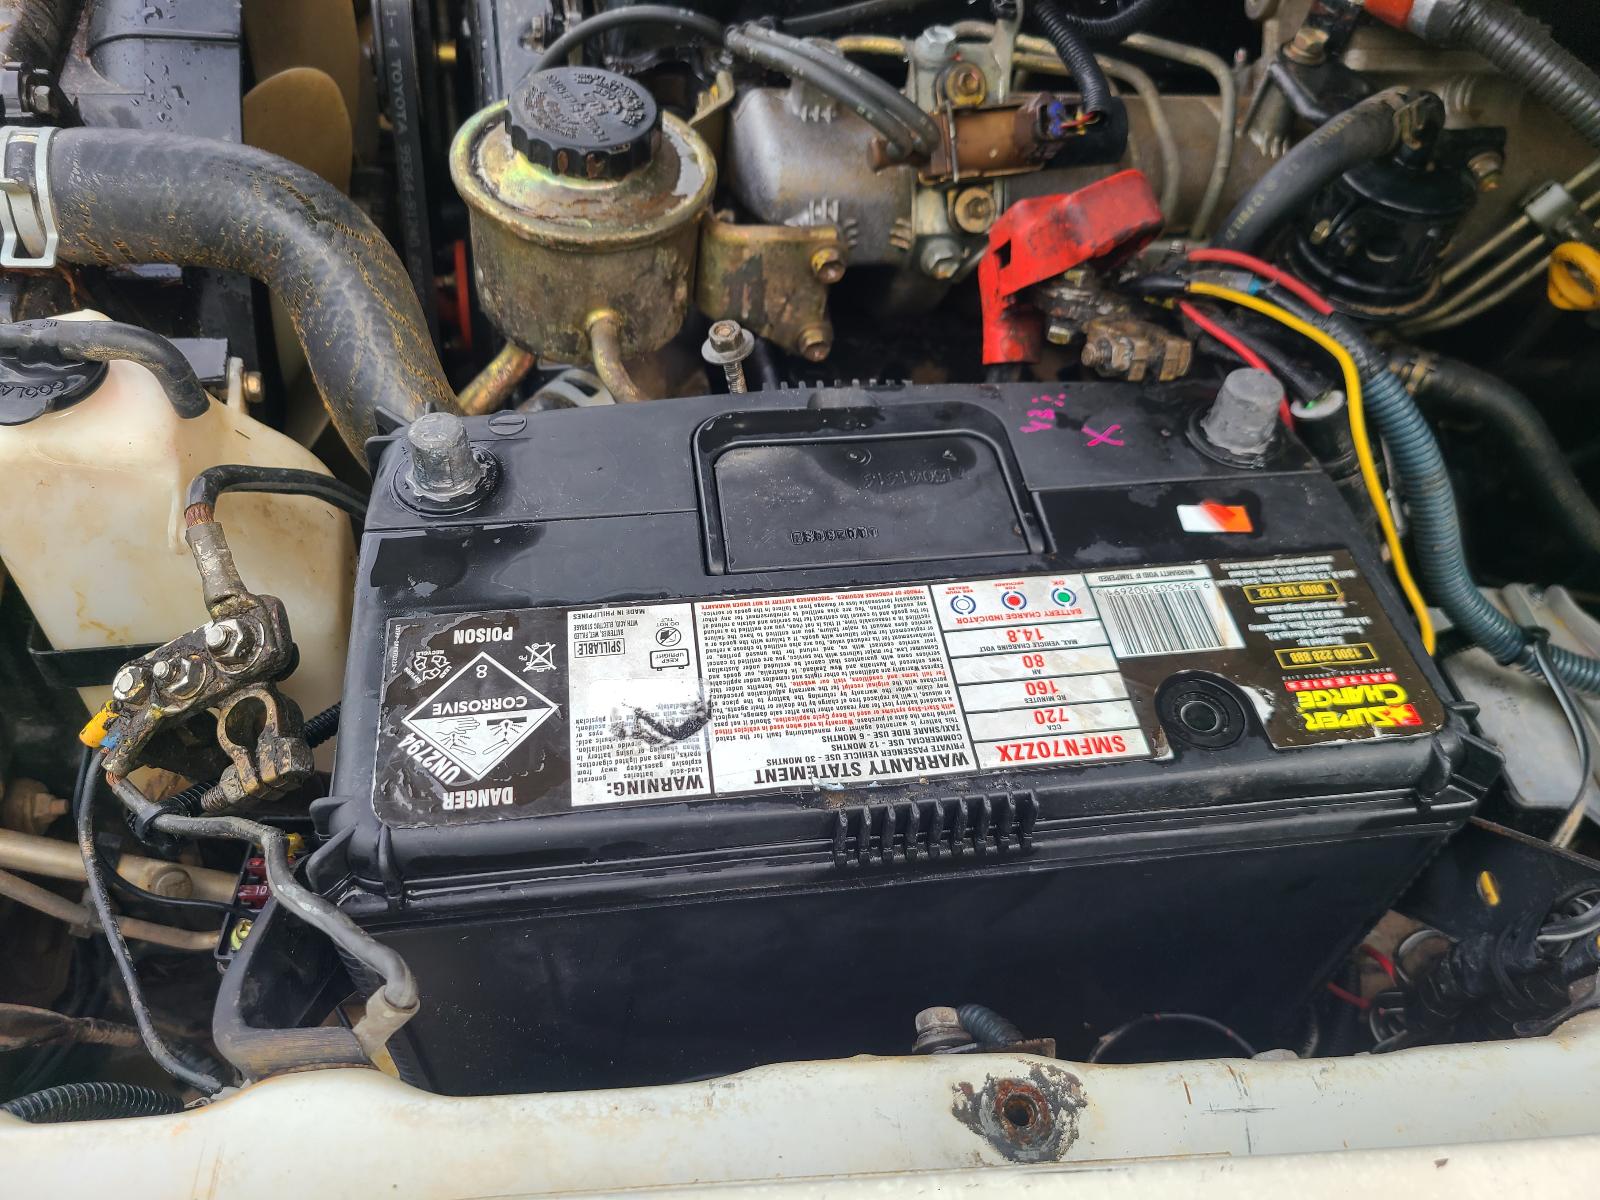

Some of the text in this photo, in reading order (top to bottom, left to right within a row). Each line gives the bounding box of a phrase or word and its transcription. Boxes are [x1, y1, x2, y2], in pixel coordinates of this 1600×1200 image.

[390, 58, 409, 136] TOYOTA
[0, 380, 65, 399] COOLA
[1097, 573, 1134, 582] TAMPERED
[1158, 569, 1196, 577] WARRANTY
[1152, 583, 1195, 592] 324503
[1256, 587, 1277, 598] 122
[573, 609, 614, 621] PHILIPPINES
[626, 607, 645, 616] MADE
[955, 608, 1082, 624] BATTERY CHARGE INDICATOR
[615, 619, 626, 627] ACID,
[452, 626, 512, 643] POISON
[574, 628, 623, 639] BATTERIES, WET, FILLED
[1006, 628, 1045, 642] 14.8
[578, 640, 620, 656] SPILLABLE
[1332, 646, 1363, 660] 1300
[656, 651, 684, 659] UPRIGHT
[1311, 649, 1334, 662] 228
[1021, 654, 1045, 668] 80
[403, 666, 421, 683] RETURN
[438, 665, 451, 678] LEAD
[475, 663, 487, 678] 8
[1024, 680, 1059, 695] 160
[1286, 674, 1394, 690] BATTERIES
[431, 695, 526, 714] CORROSIVE
[1023, 695, 1055, 703] MINUTES
[1032, 708, 1069, 724] 720
[575, 722, 605, 732] accident,
[891, 728, 911, 737] RIDE
[912, 724, 960, 735] TAXI/SHARE
[588, 729, 603, 737] eyes
[821, 733, 857, 742] MONTHS
[872, 730, 889, 738] USE
[868, 740, 879, 748] 12
[887, 738, 905, 746] USE
[905, 733, 963, 745] COMMERCIAL
[576, 743, 613, 753] ventilation.
[830, 741, 867, 751] MONTHS
[880, 745, 929, 756] PASSENGER
[930, 742, 966, 752] PRIVATE
[995, 735, 1126, 762] SMFN70ZZX
[396, 731, 460, 784] UN2794
[587, 751, 610, 760] battery
[616, 748, 633, 756] using
[654, 752, 675, 761] flames
[677, 749, 701, 758] sparks,
[824, 753, 841, 761] USE
[842, 749, 879, 759] VEHICLE
[577, 758, 612, 769] cigarettes.
[615, 756, 637, 765] lighted
[671, 758, 702, 767] explosive
[766, 756, 803, 766] MONTHS
[804, 755, 816, 763] 30
[601, 766, 617, 774] away
[752, 751, 970, 785] WARRANTY STATEMENT
[577, 766, 703, 783] Lead-acid batteries generate
[607, 774, 704, 796] WARNING:
[441, 786, 512, 809] DANGER
